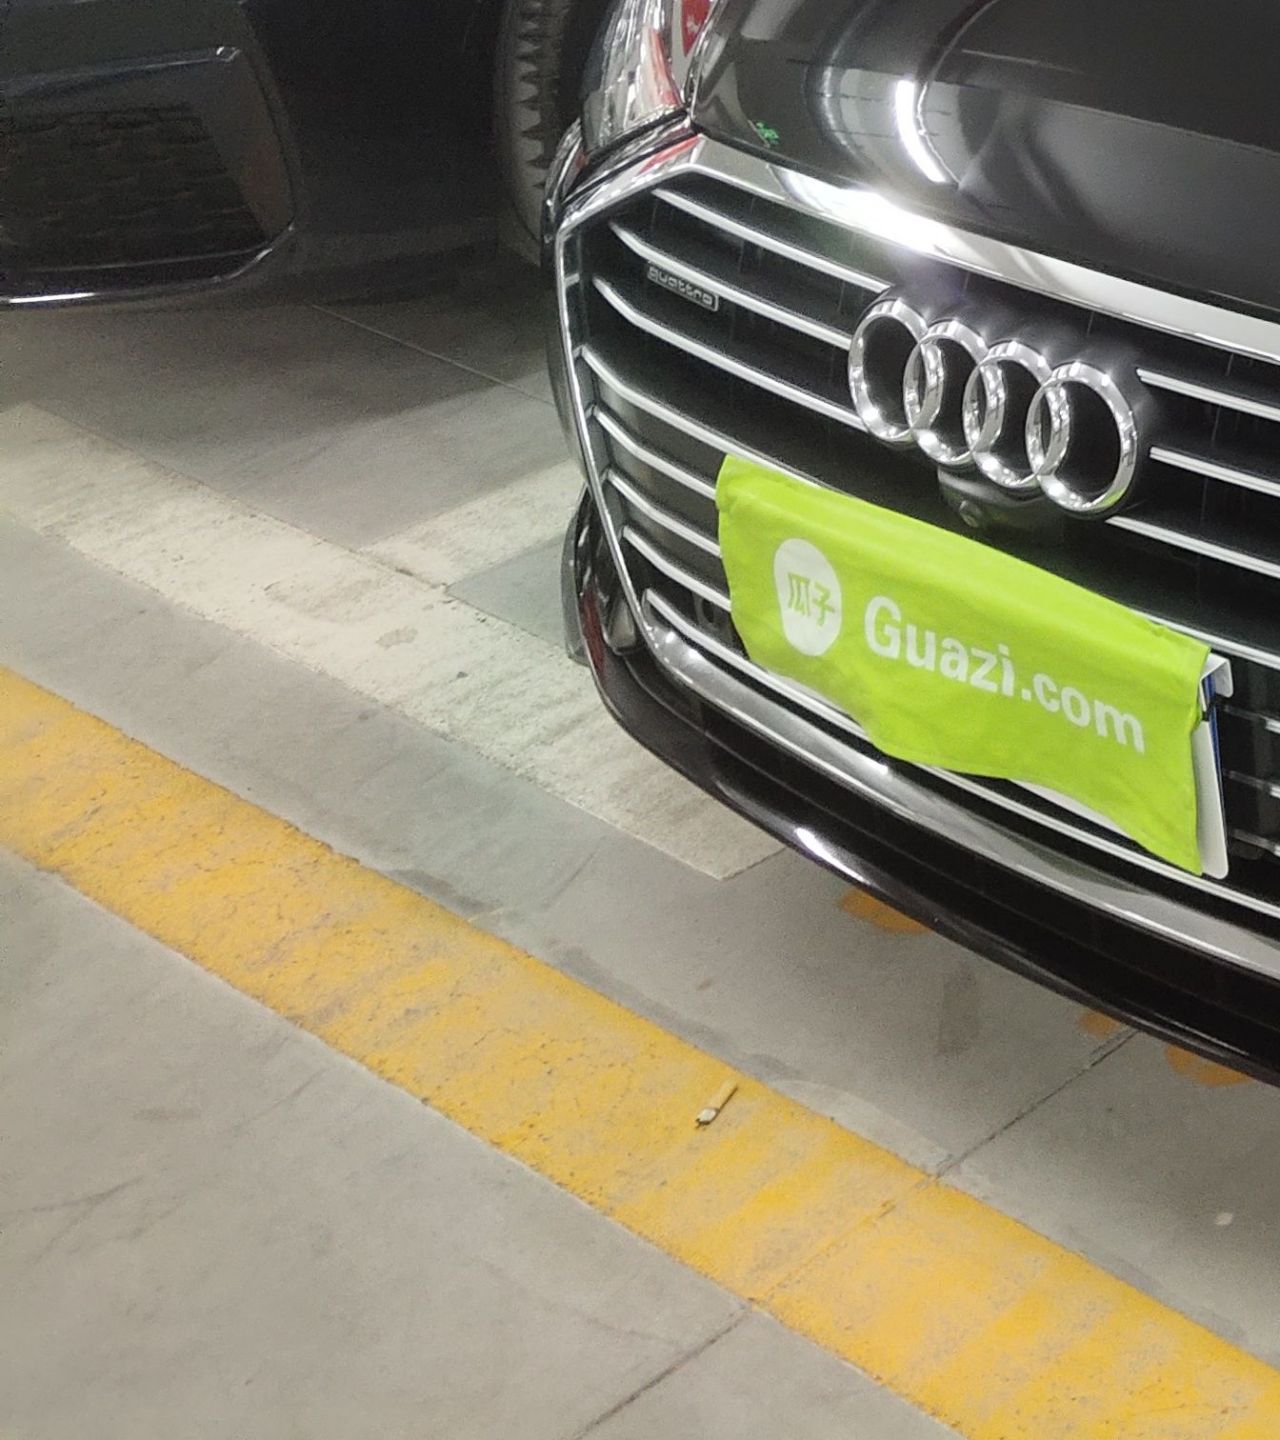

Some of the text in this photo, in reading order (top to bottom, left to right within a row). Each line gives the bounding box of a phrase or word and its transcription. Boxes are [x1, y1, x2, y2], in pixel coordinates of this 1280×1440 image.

[647, 266, 713, 306] quattro
[786, 571, 836, 626] 瓜子
[863, 594, 1146, 757] Guazi.com
